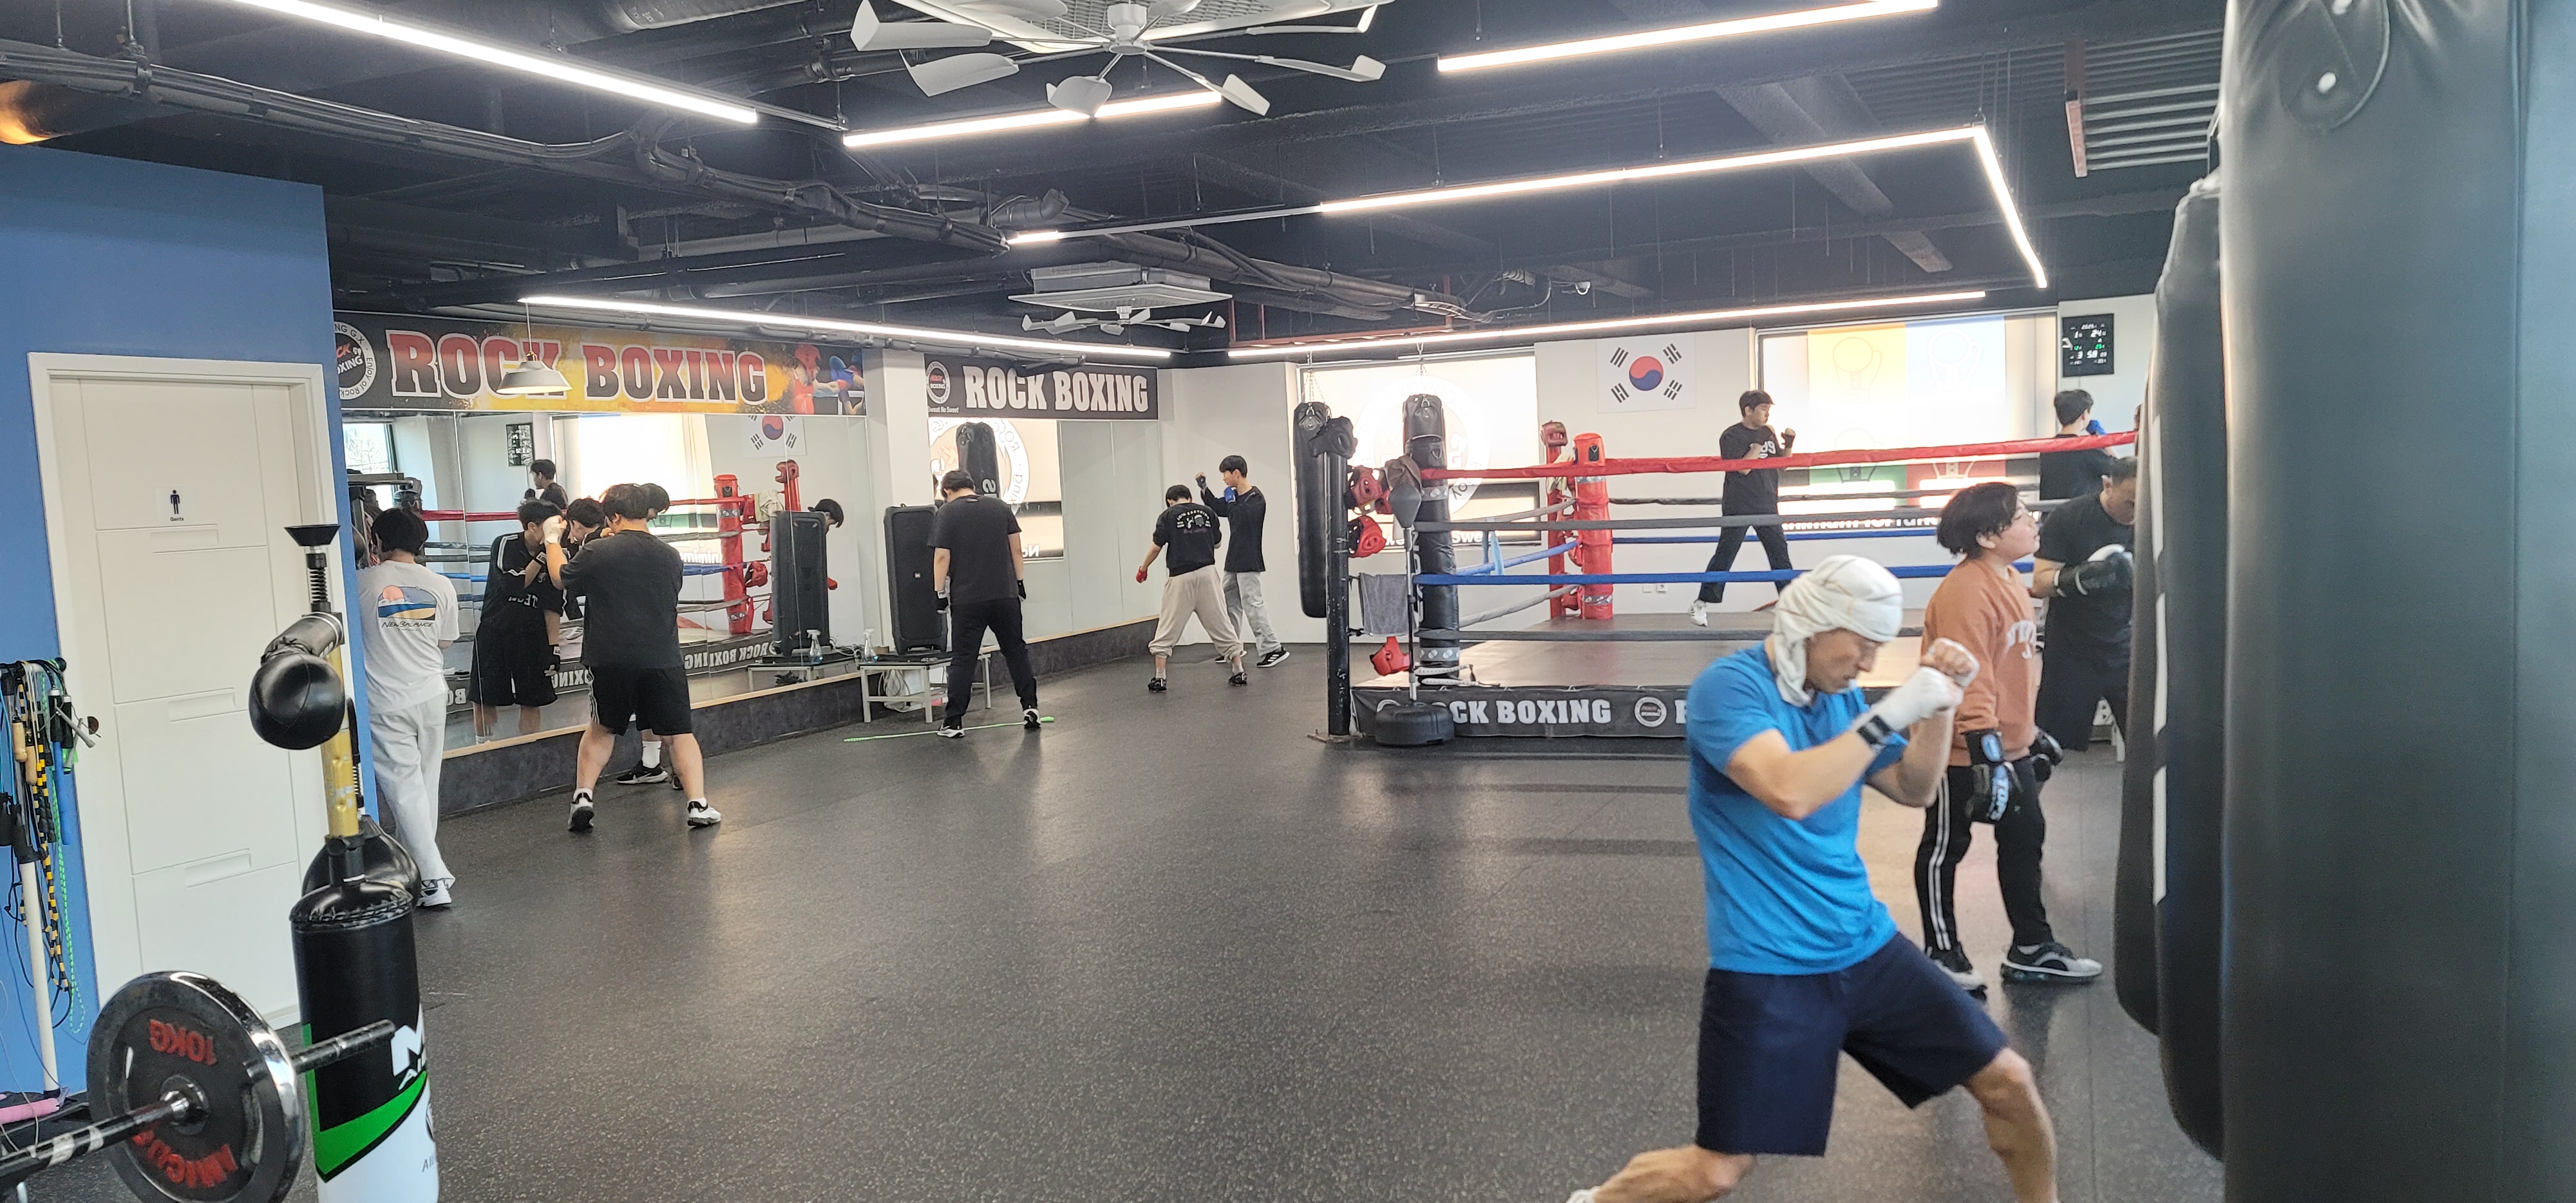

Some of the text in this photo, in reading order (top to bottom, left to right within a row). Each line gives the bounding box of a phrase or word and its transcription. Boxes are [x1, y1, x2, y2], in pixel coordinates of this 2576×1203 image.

[337, 356, 364, 375] XING
[582, 343, 768, 406] BOXING
[962, 365, 1149, 412] ROCK BOXING
[1432, 699, 1611, 724] CK BOXING
[149, 1018, 218, 1066] 10KG
